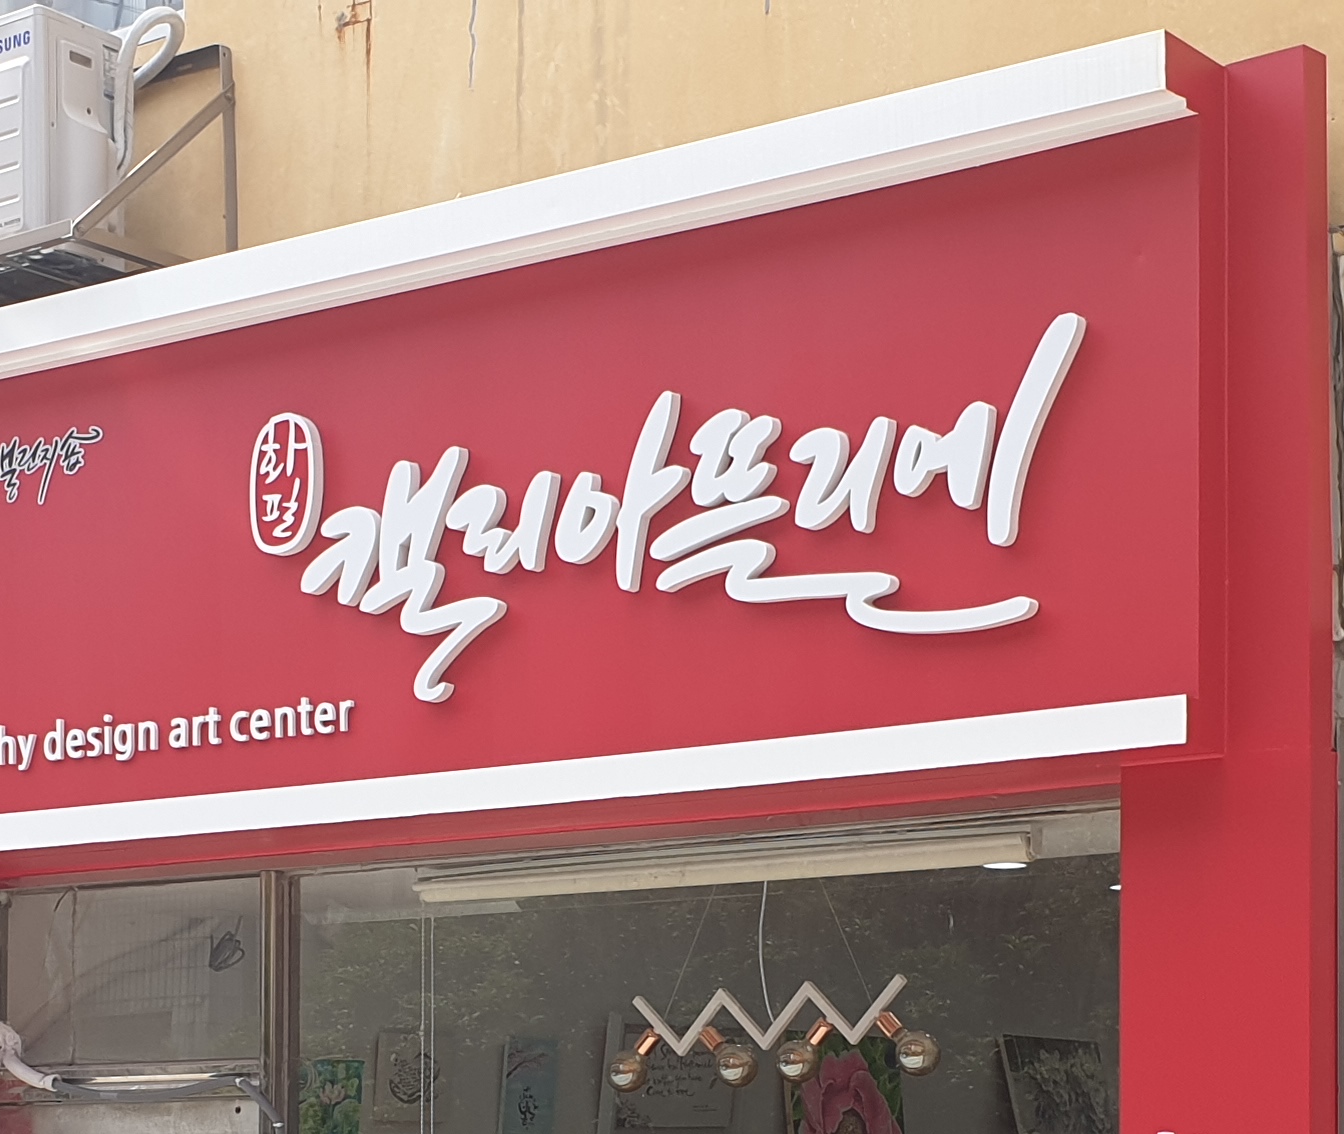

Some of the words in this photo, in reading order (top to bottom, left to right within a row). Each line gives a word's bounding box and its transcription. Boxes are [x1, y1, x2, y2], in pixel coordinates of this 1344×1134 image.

[301, 312, 1087, 702] 캘리아뜰리에
[43, 714, 158, 762] design
[168, 706, 222, 750] art
[229, 696, 355, 743] center
